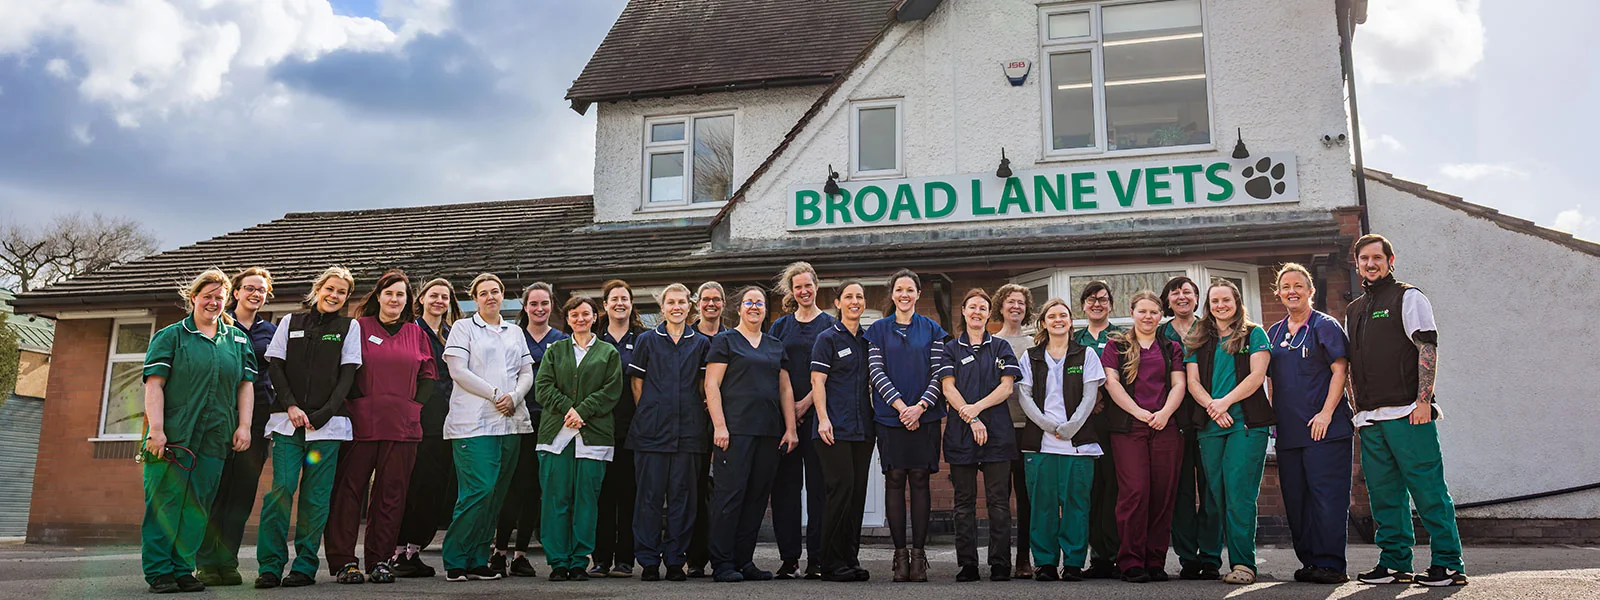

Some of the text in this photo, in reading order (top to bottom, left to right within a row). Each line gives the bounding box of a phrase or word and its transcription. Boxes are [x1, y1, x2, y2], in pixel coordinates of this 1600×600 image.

[1008, 61, 1026, 69] JSB
[795, 162, 1235, 226] BROAD LANE VETS
